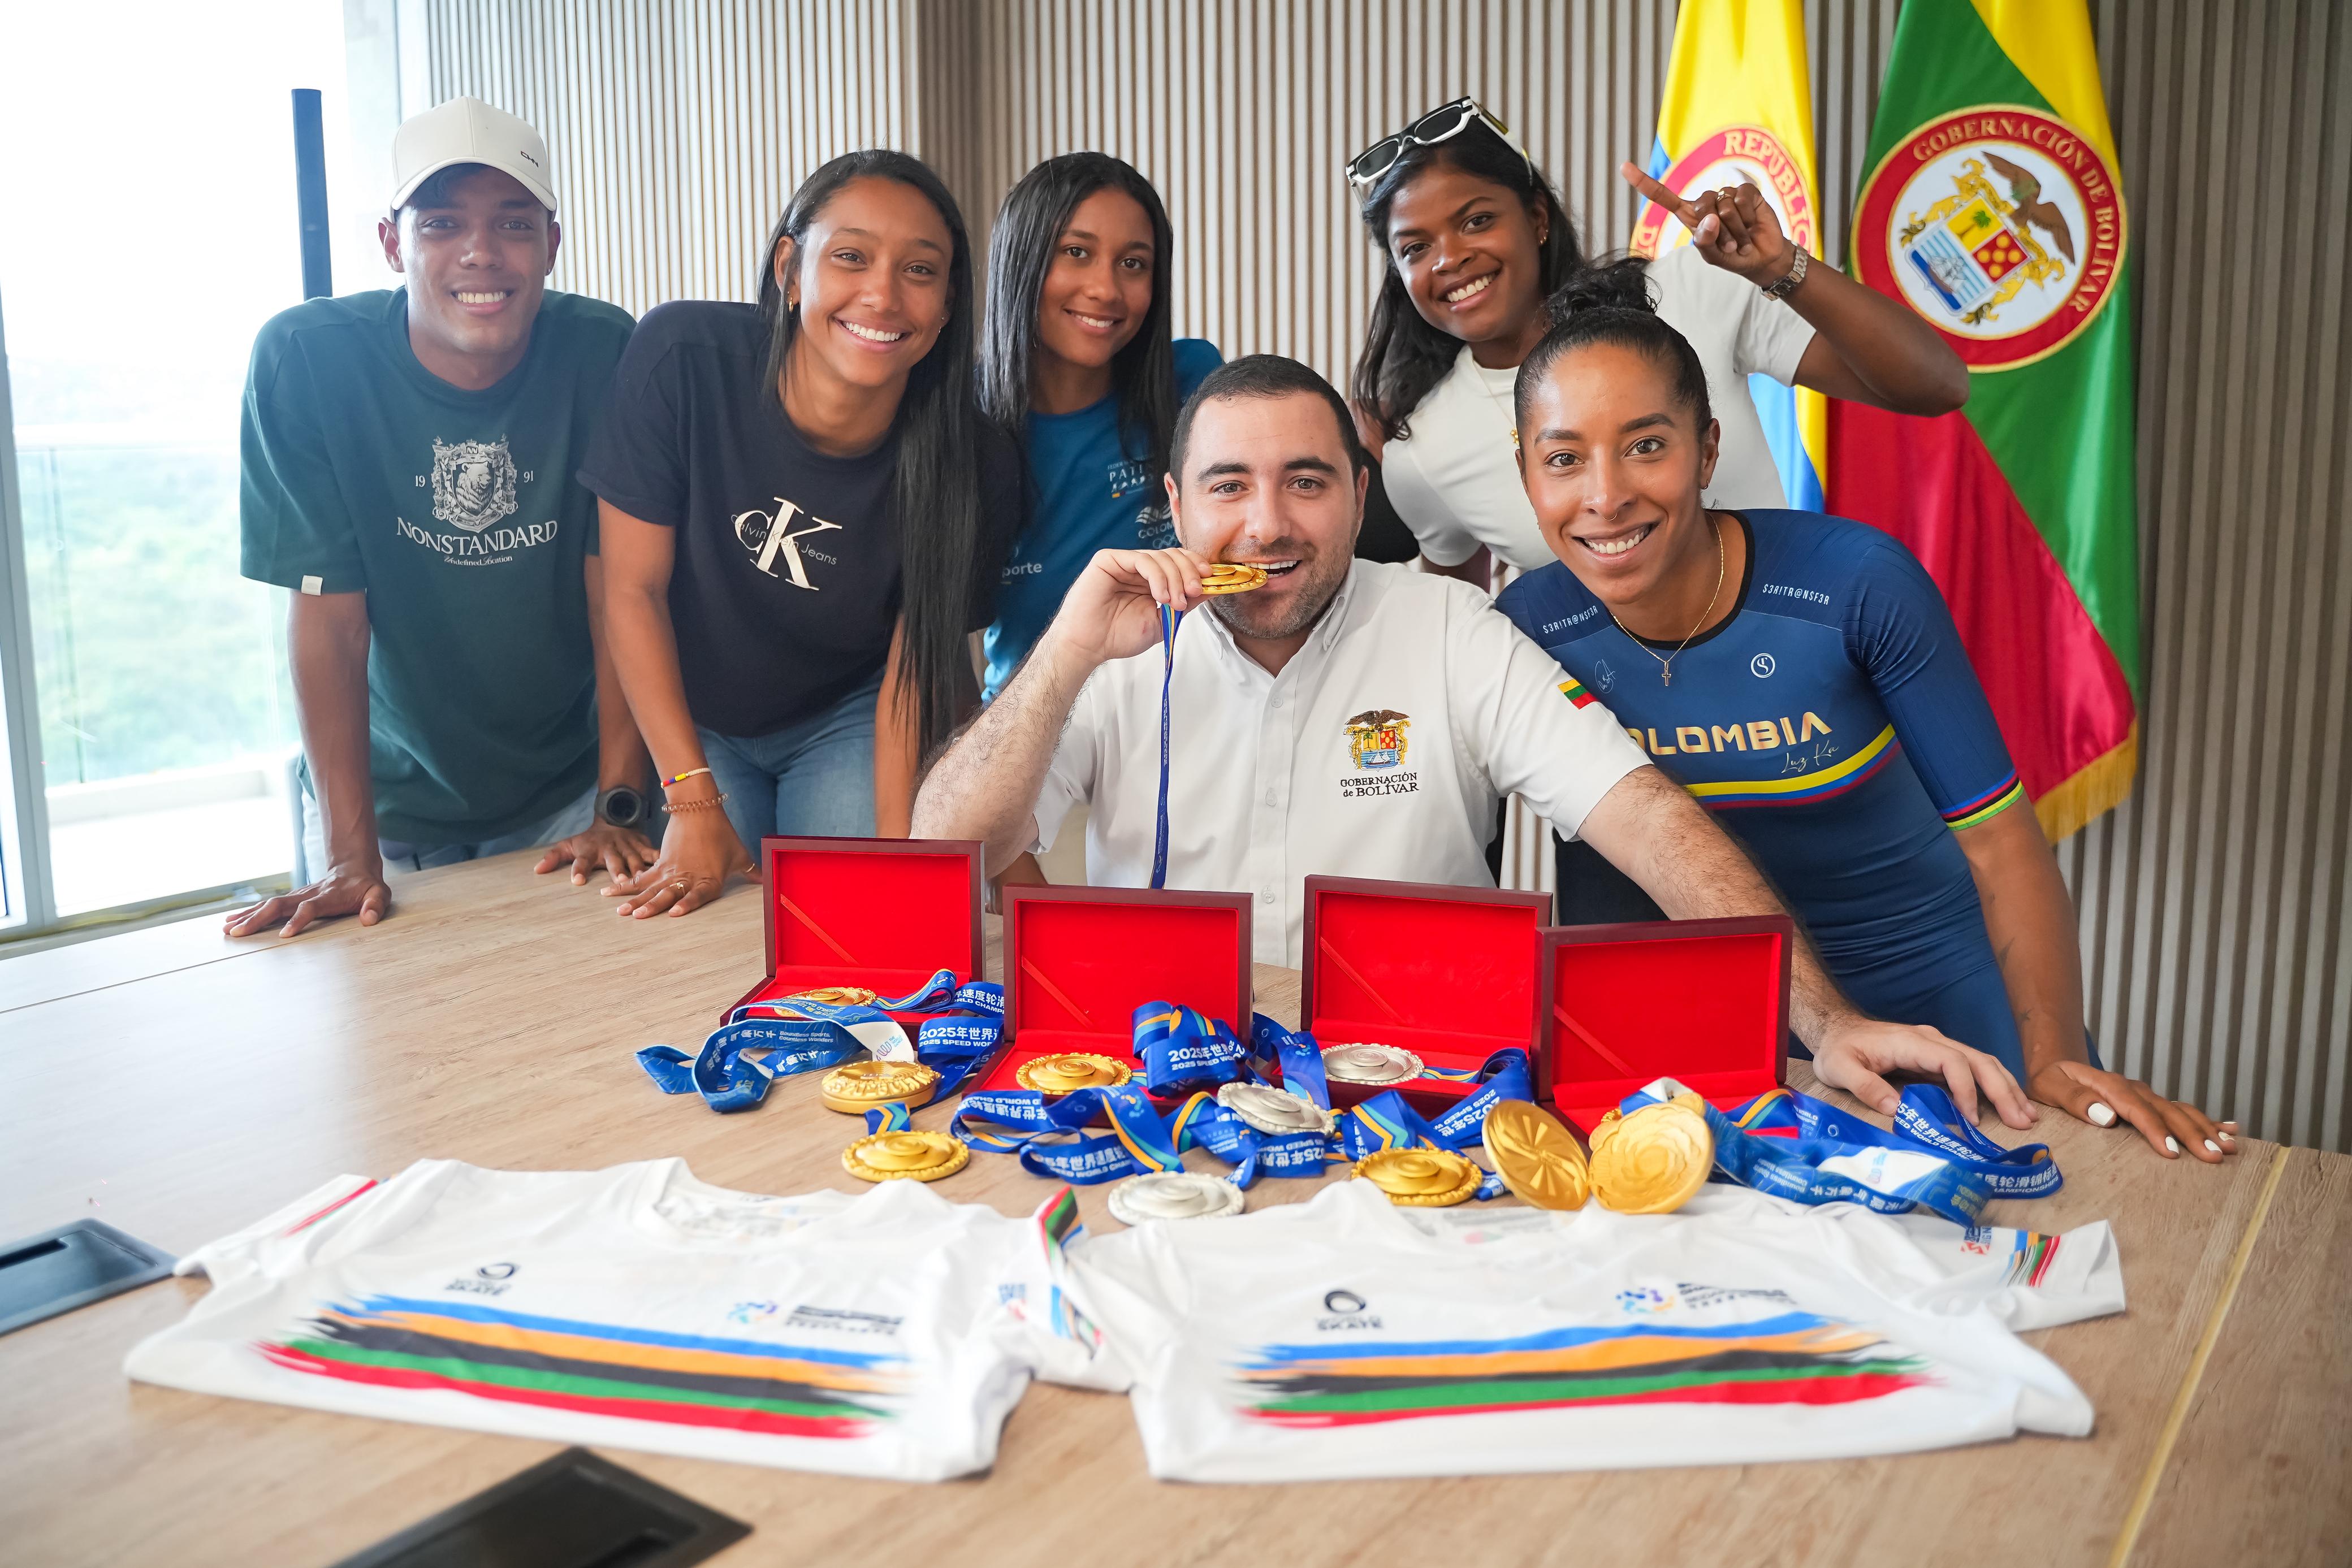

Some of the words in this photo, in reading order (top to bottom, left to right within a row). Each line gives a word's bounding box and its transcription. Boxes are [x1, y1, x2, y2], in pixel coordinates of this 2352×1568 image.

[1913, 117, 2090, 170] GOBERNACIÓN
[2081, 169, 2108, 203] DE
[2069, 205, 2116, 313] BOLÍVAR
[415, 475, 426, 487] 19
[524, 470, 534, 483] 91
[396, 517, 558, 556] NONSTANDARD
[769, 530, 799, 550] Kein
[801, 543, 837, 565] Jeans
[1002, 562, 1043, 578] porte
[1340, 772, 1417, 787] GOBERNACIÓN
[1343, 789, 1354, 798] de
[1355, 782, 1420, 797] BOLÍVAR
[1443, 1105, 1473, 1125] SPEED
[1909, 1128, 1940, 1147] WORLD
